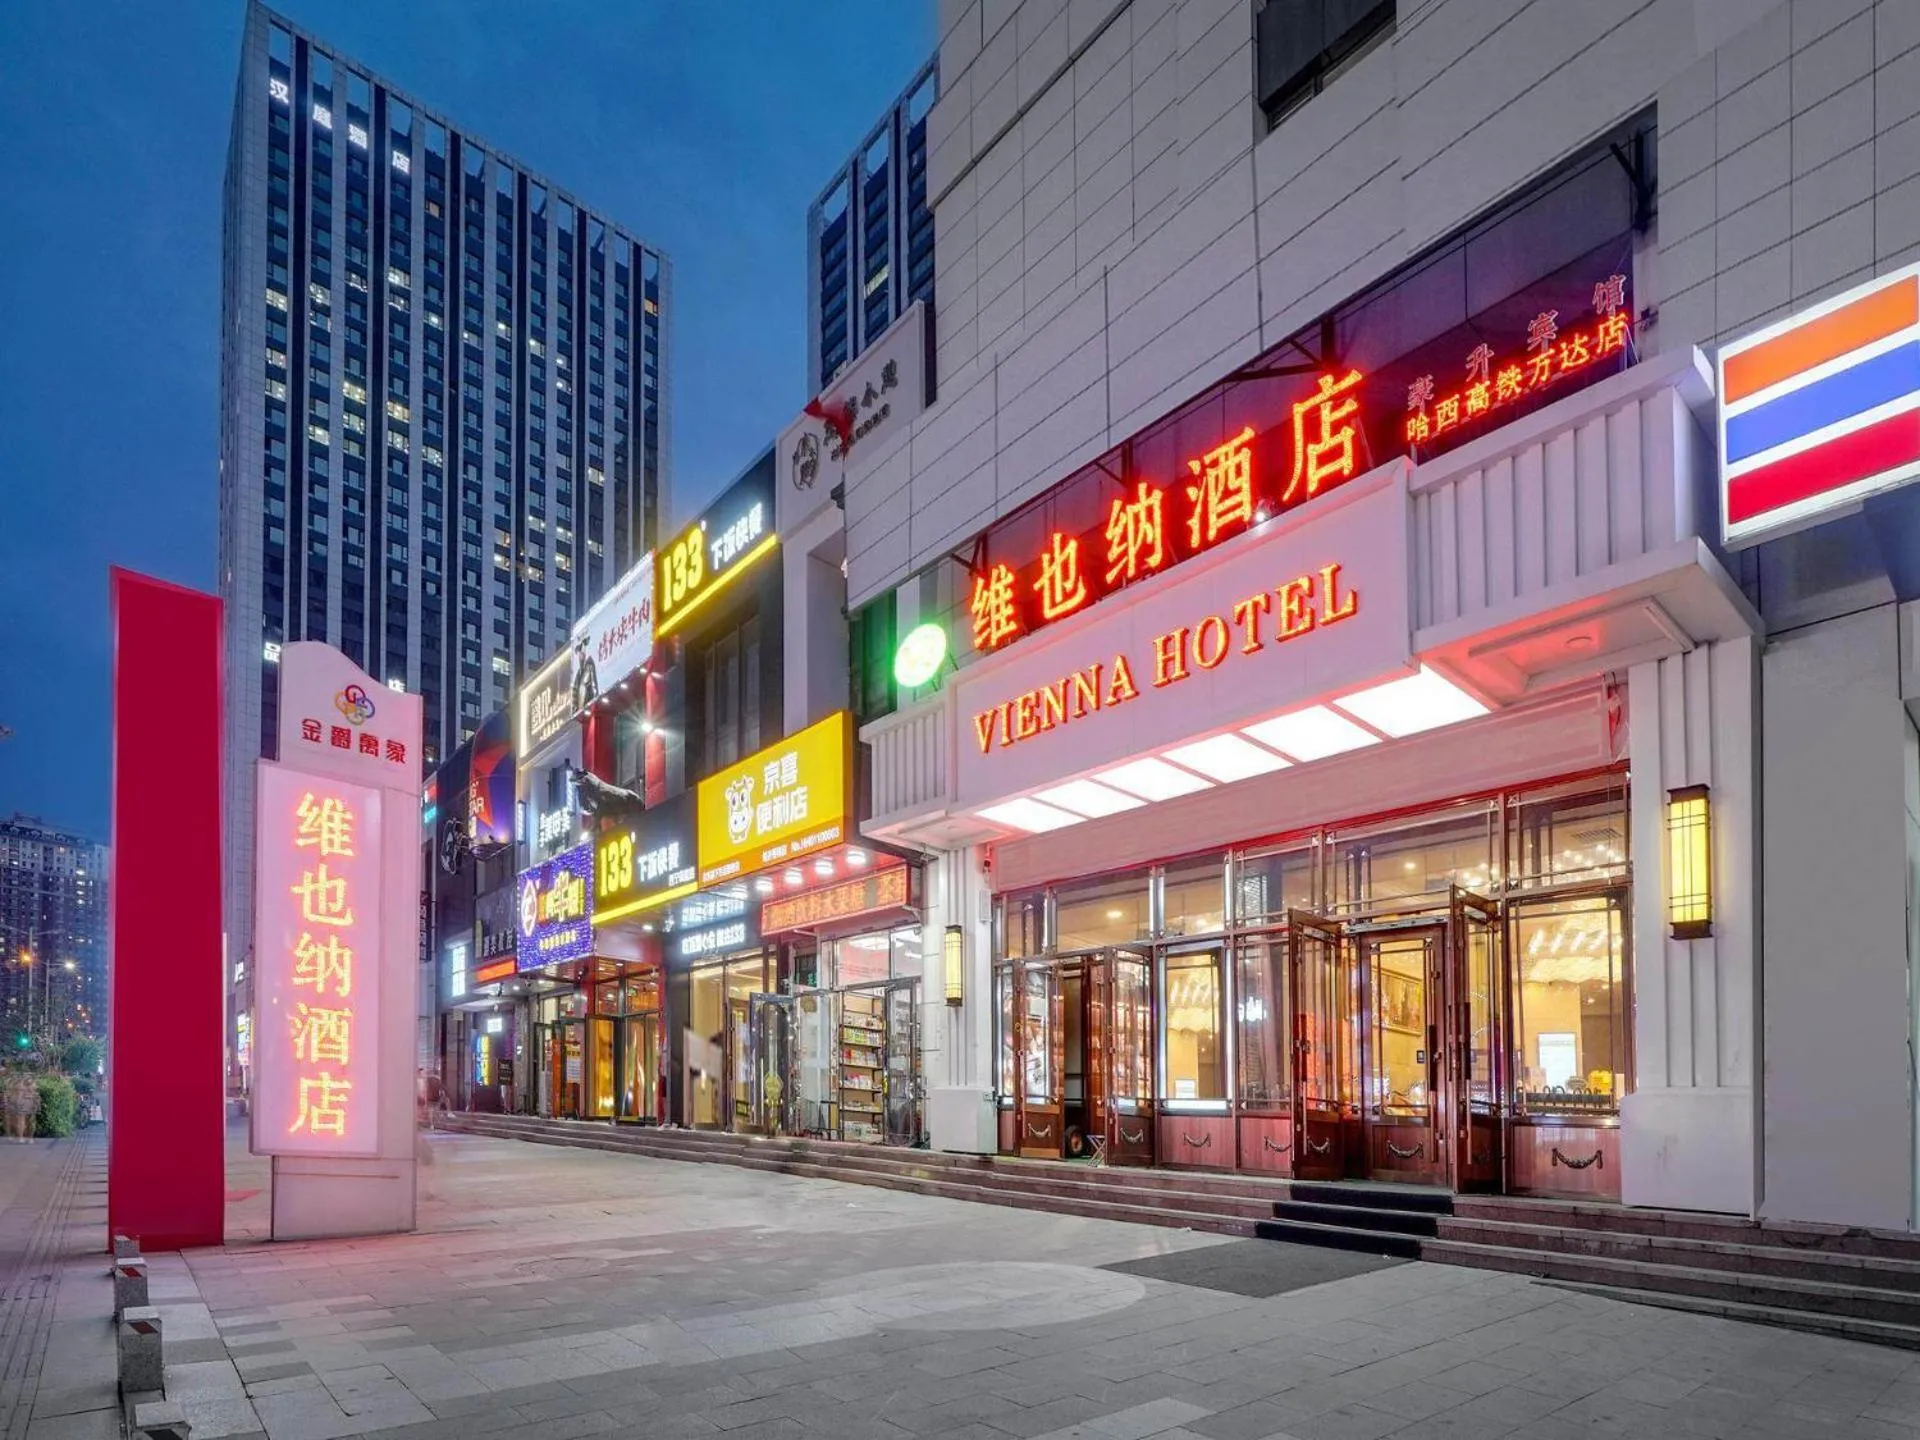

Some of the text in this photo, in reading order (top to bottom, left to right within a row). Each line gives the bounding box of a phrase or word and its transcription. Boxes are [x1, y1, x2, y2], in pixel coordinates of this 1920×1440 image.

[1406, 312, 1628, 442] 哈西高铁万达店
[970, 368, 1363, 651] 维也纳酒店
[971, 562, 1359, 754] VIENNA HOTEL
[756, 785, 808, 835] 便利店
[763, 751, 798, 797] 京喜
[288, 791, 356, 1136] 维也纳酒店
